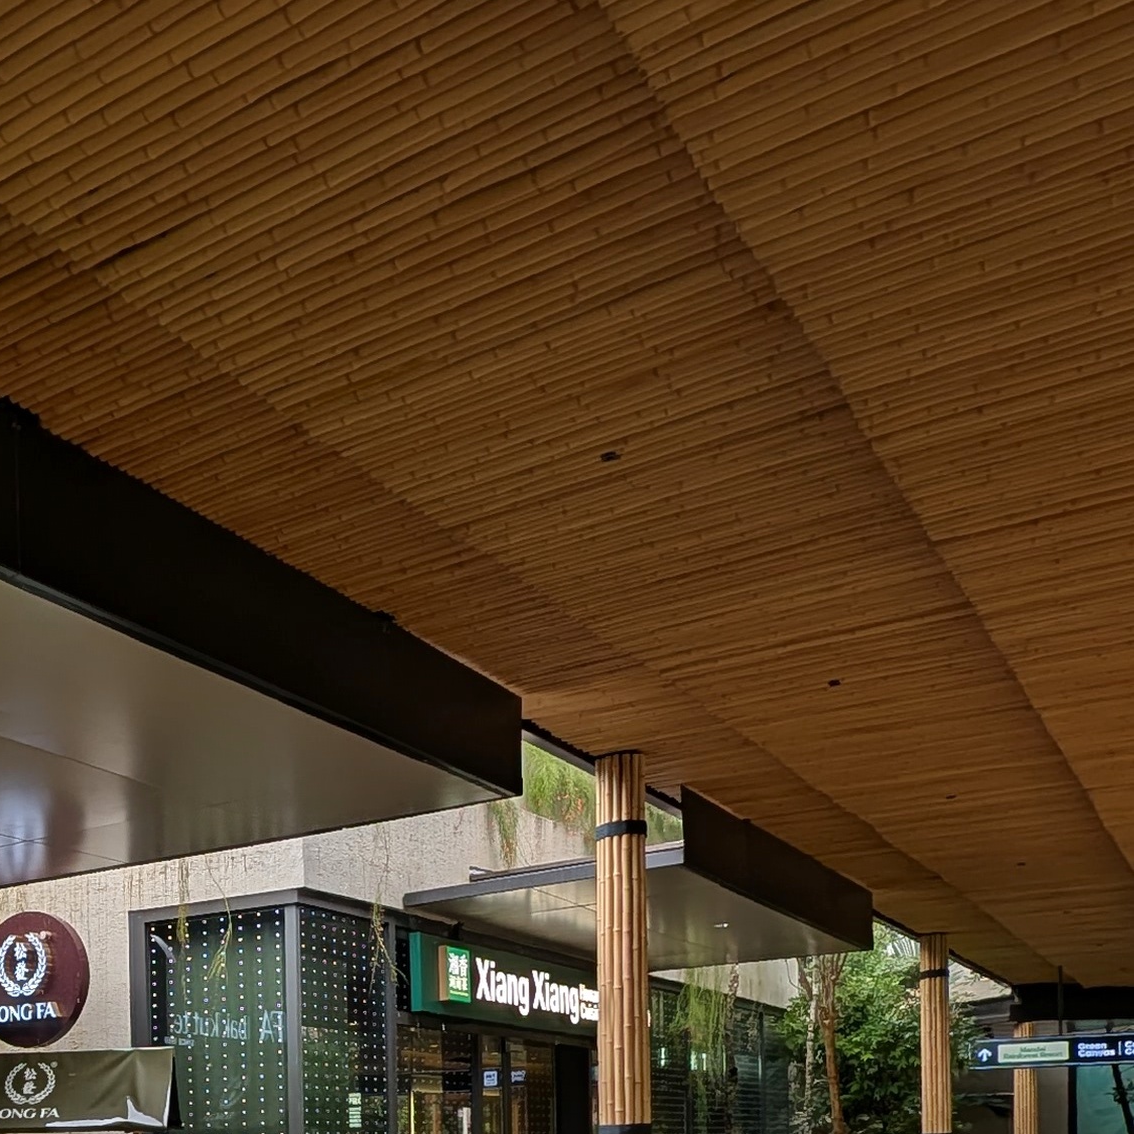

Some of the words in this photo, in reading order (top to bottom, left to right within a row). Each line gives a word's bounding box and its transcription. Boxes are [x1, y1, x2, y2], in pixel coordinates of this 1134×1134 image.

[475, 957, 530, 1016] Xiang
[531, 970, 580, 1025] Xiang
[35, 1001, 58, 1020] FA
[40, 1107, 60, 1119] FA
